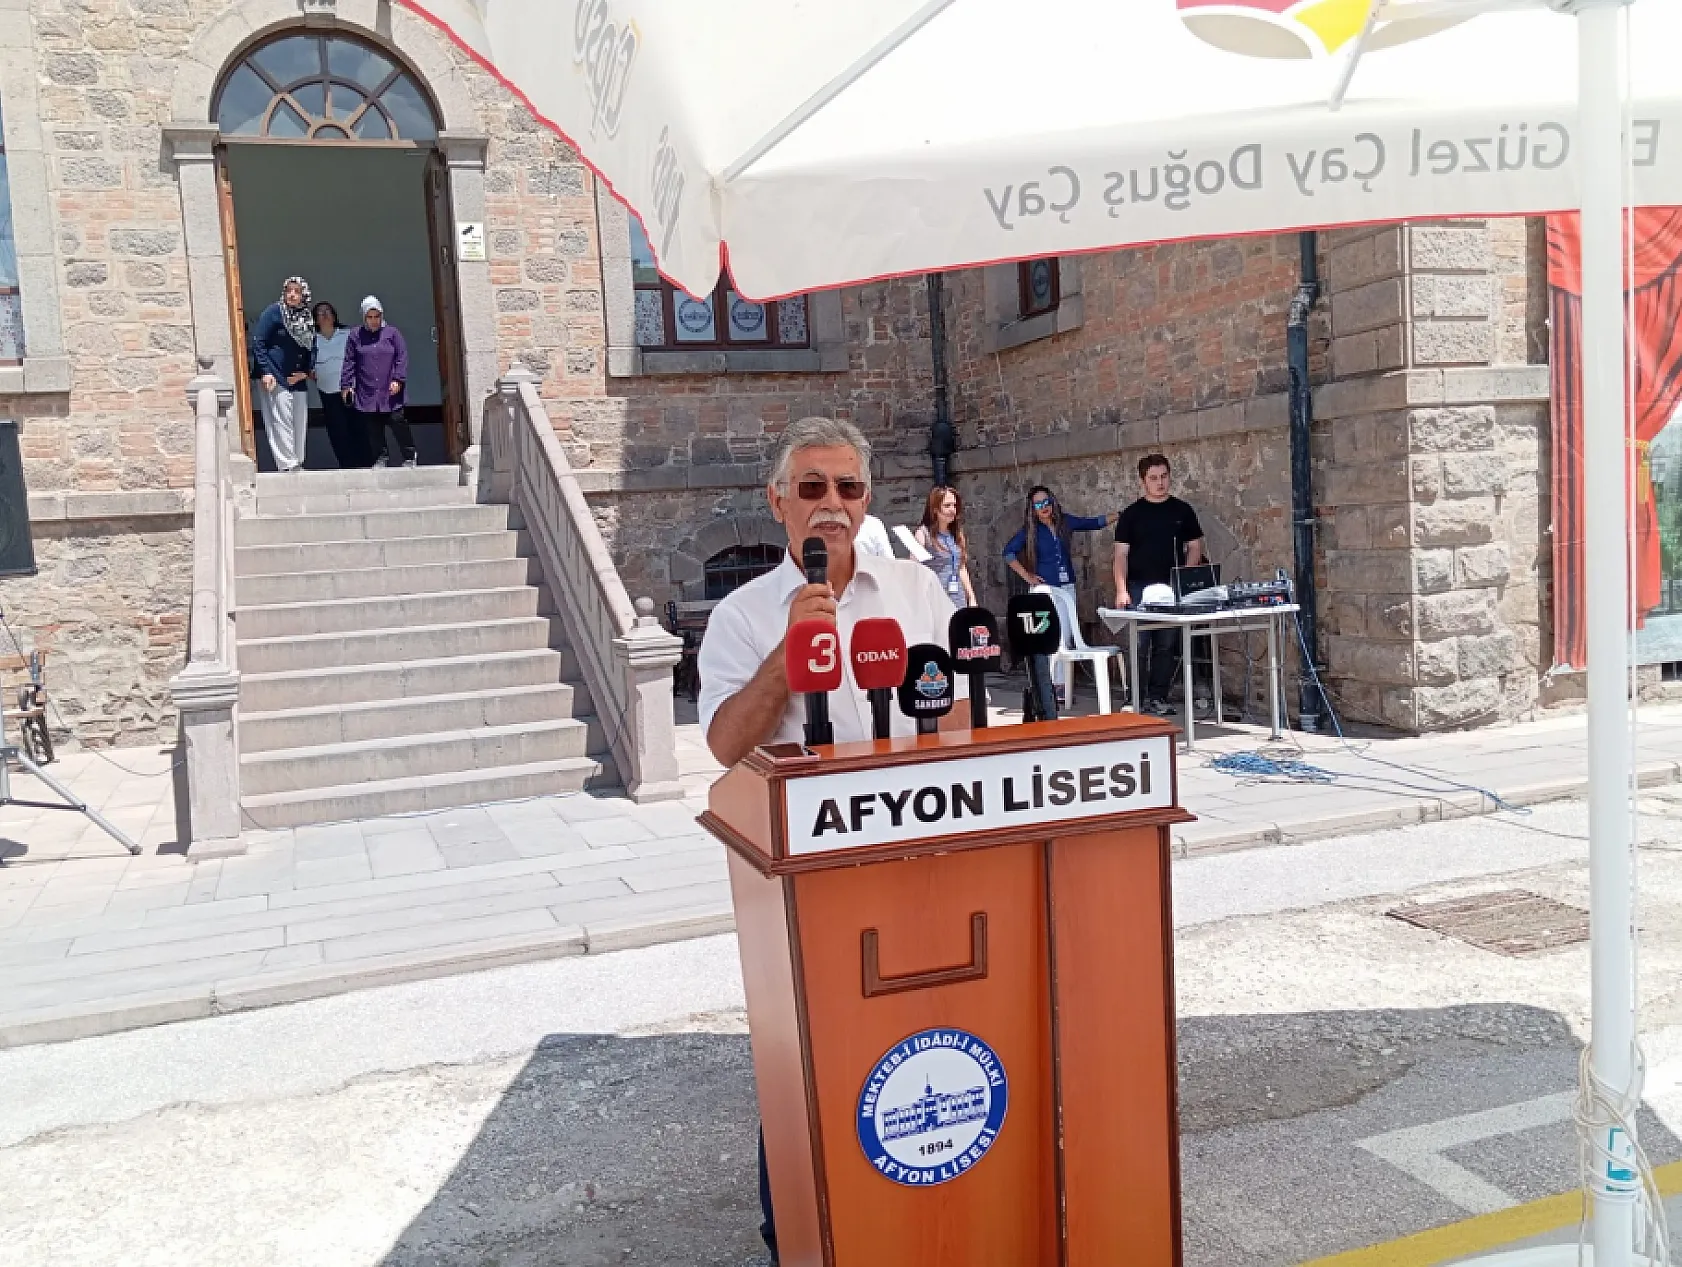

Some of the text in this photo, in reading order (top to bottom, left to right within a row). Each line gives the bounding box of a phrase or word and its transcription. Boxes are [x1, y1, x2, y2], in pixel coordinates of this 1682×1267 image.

[808, 633, 837, 673] 3
[856, 648, 900, 663] ODAK
[811, 752, 1152, 837] AFYON LİSESİ
[918, 1139, 954, 1156] 1894
[873, 1155, 935, 1183] AFYON
